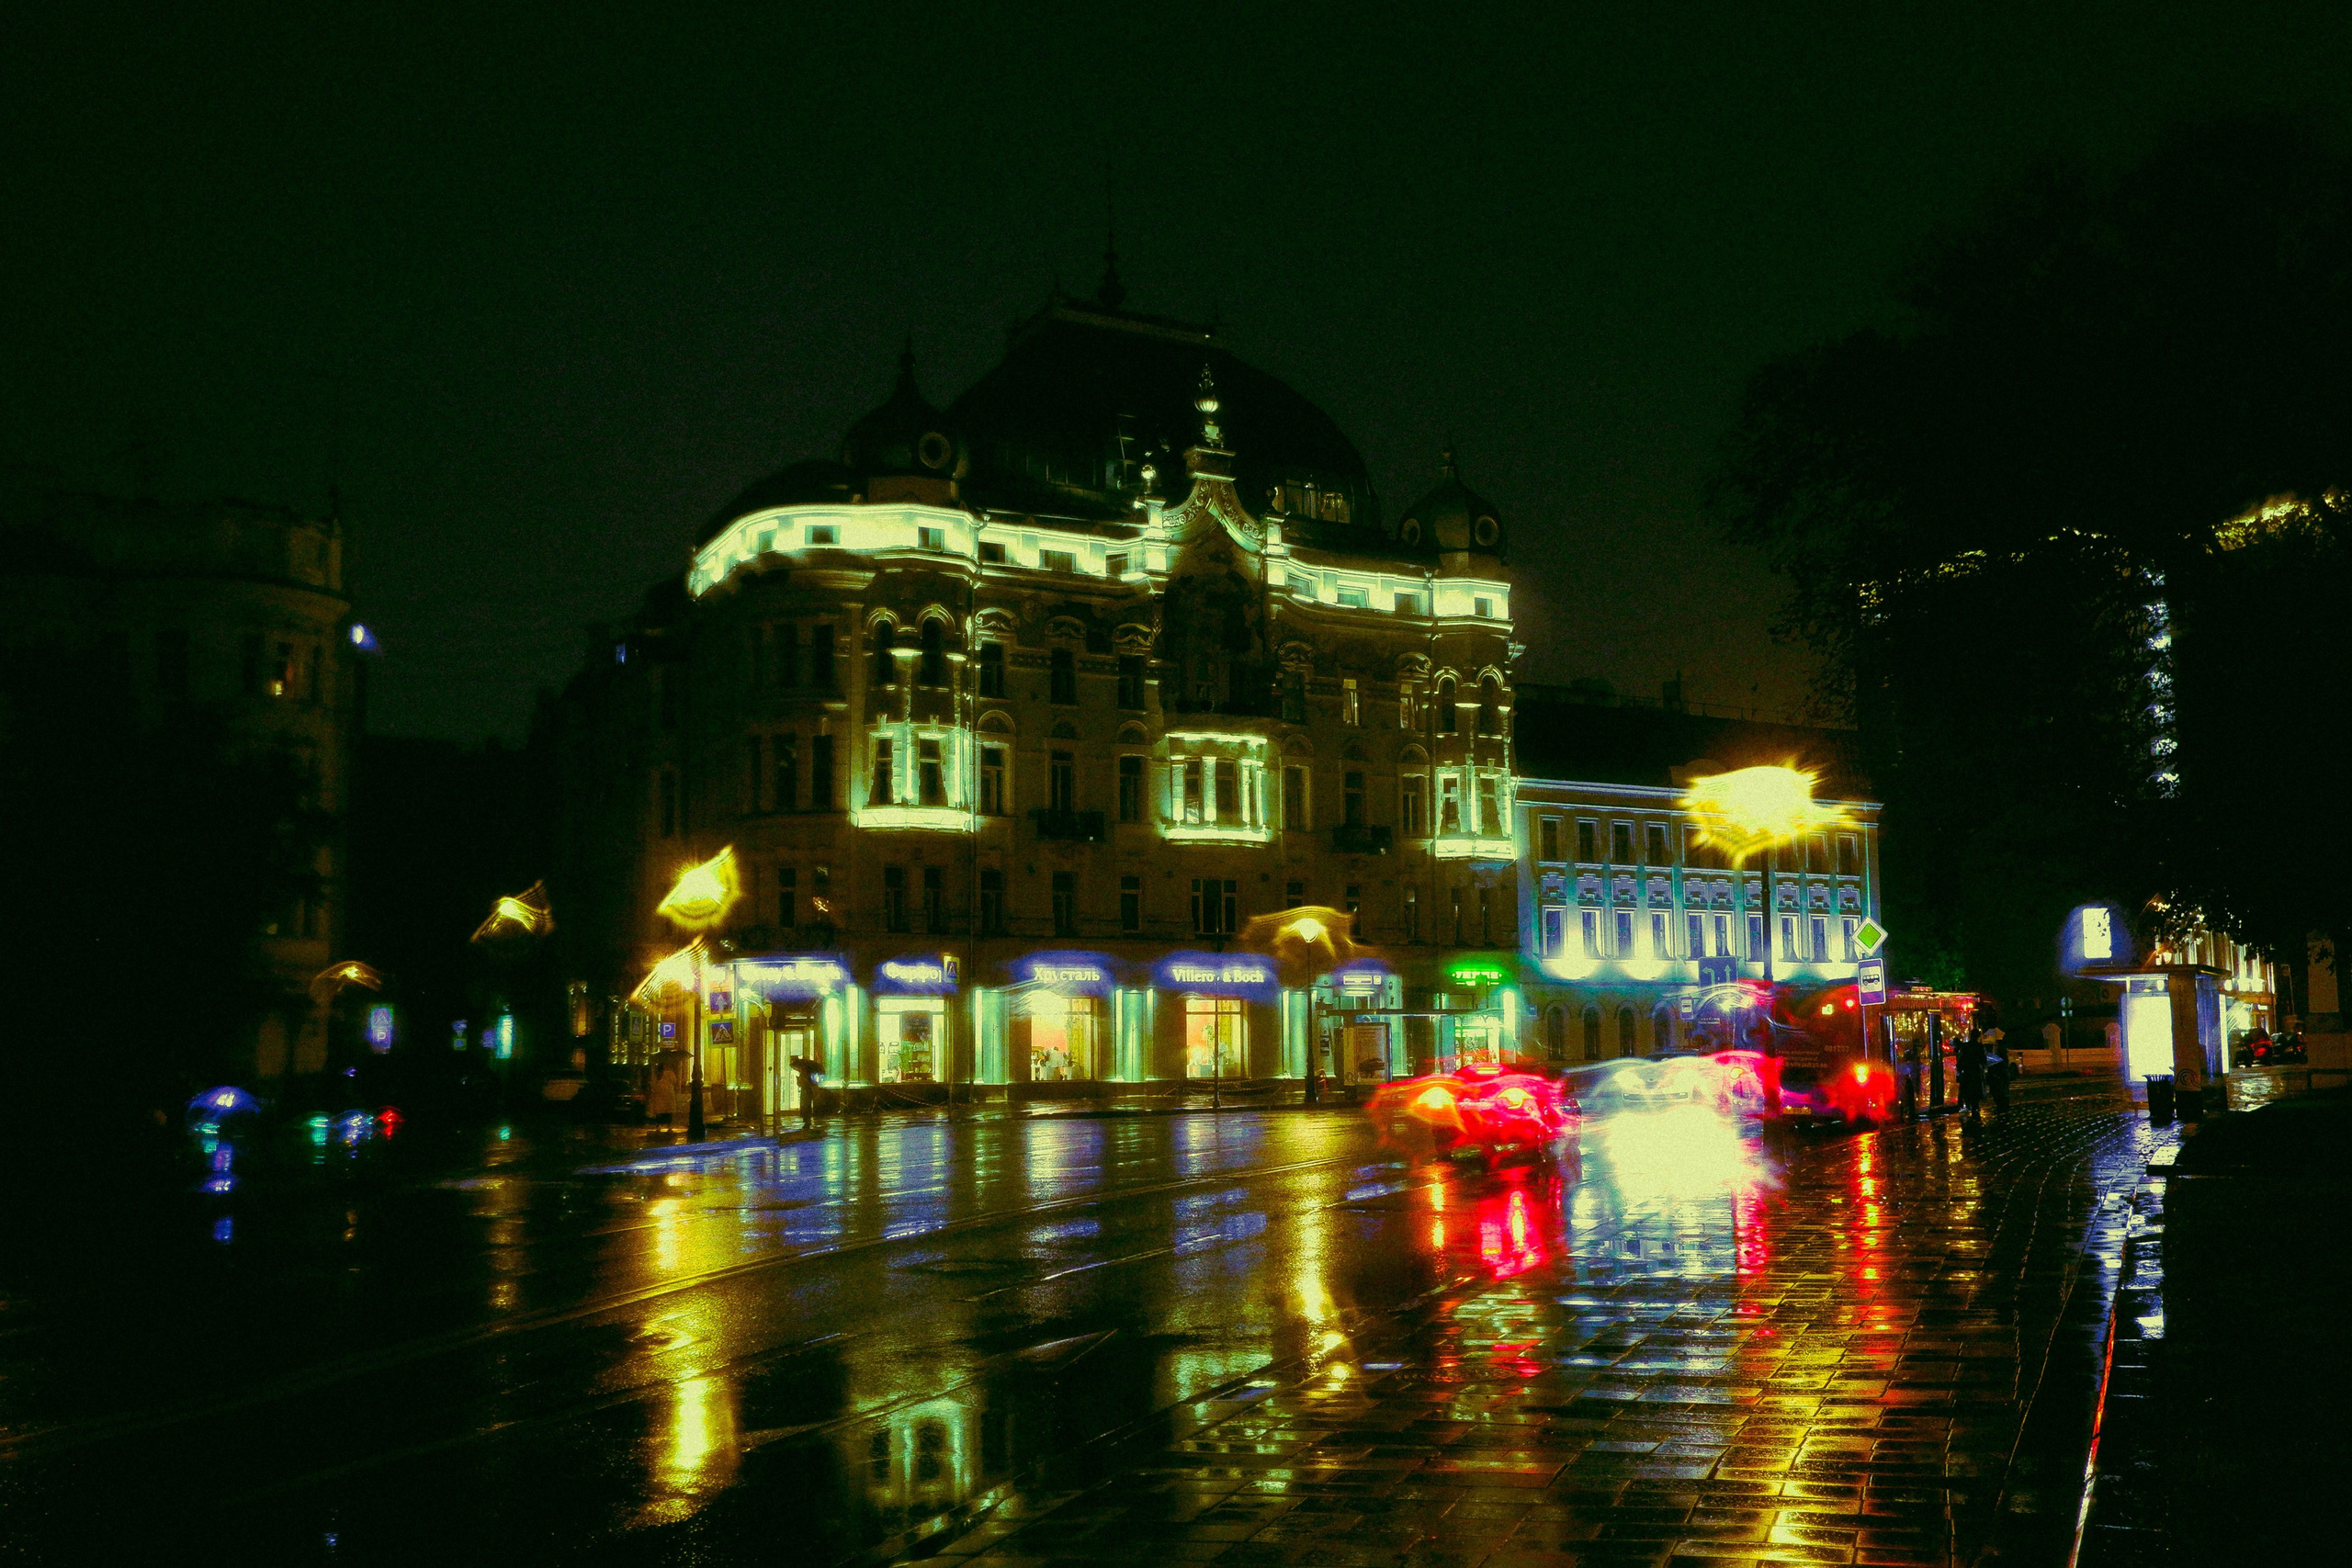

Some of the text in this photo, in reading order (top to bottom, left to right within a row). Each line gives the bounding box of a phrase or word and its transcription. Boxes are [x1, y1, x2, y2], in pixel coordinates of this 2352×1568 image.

[1223, 971, 1232, 982] &
[1233, 969, 1264, 982] Boch
[662, 1024, 672, 1036] P
